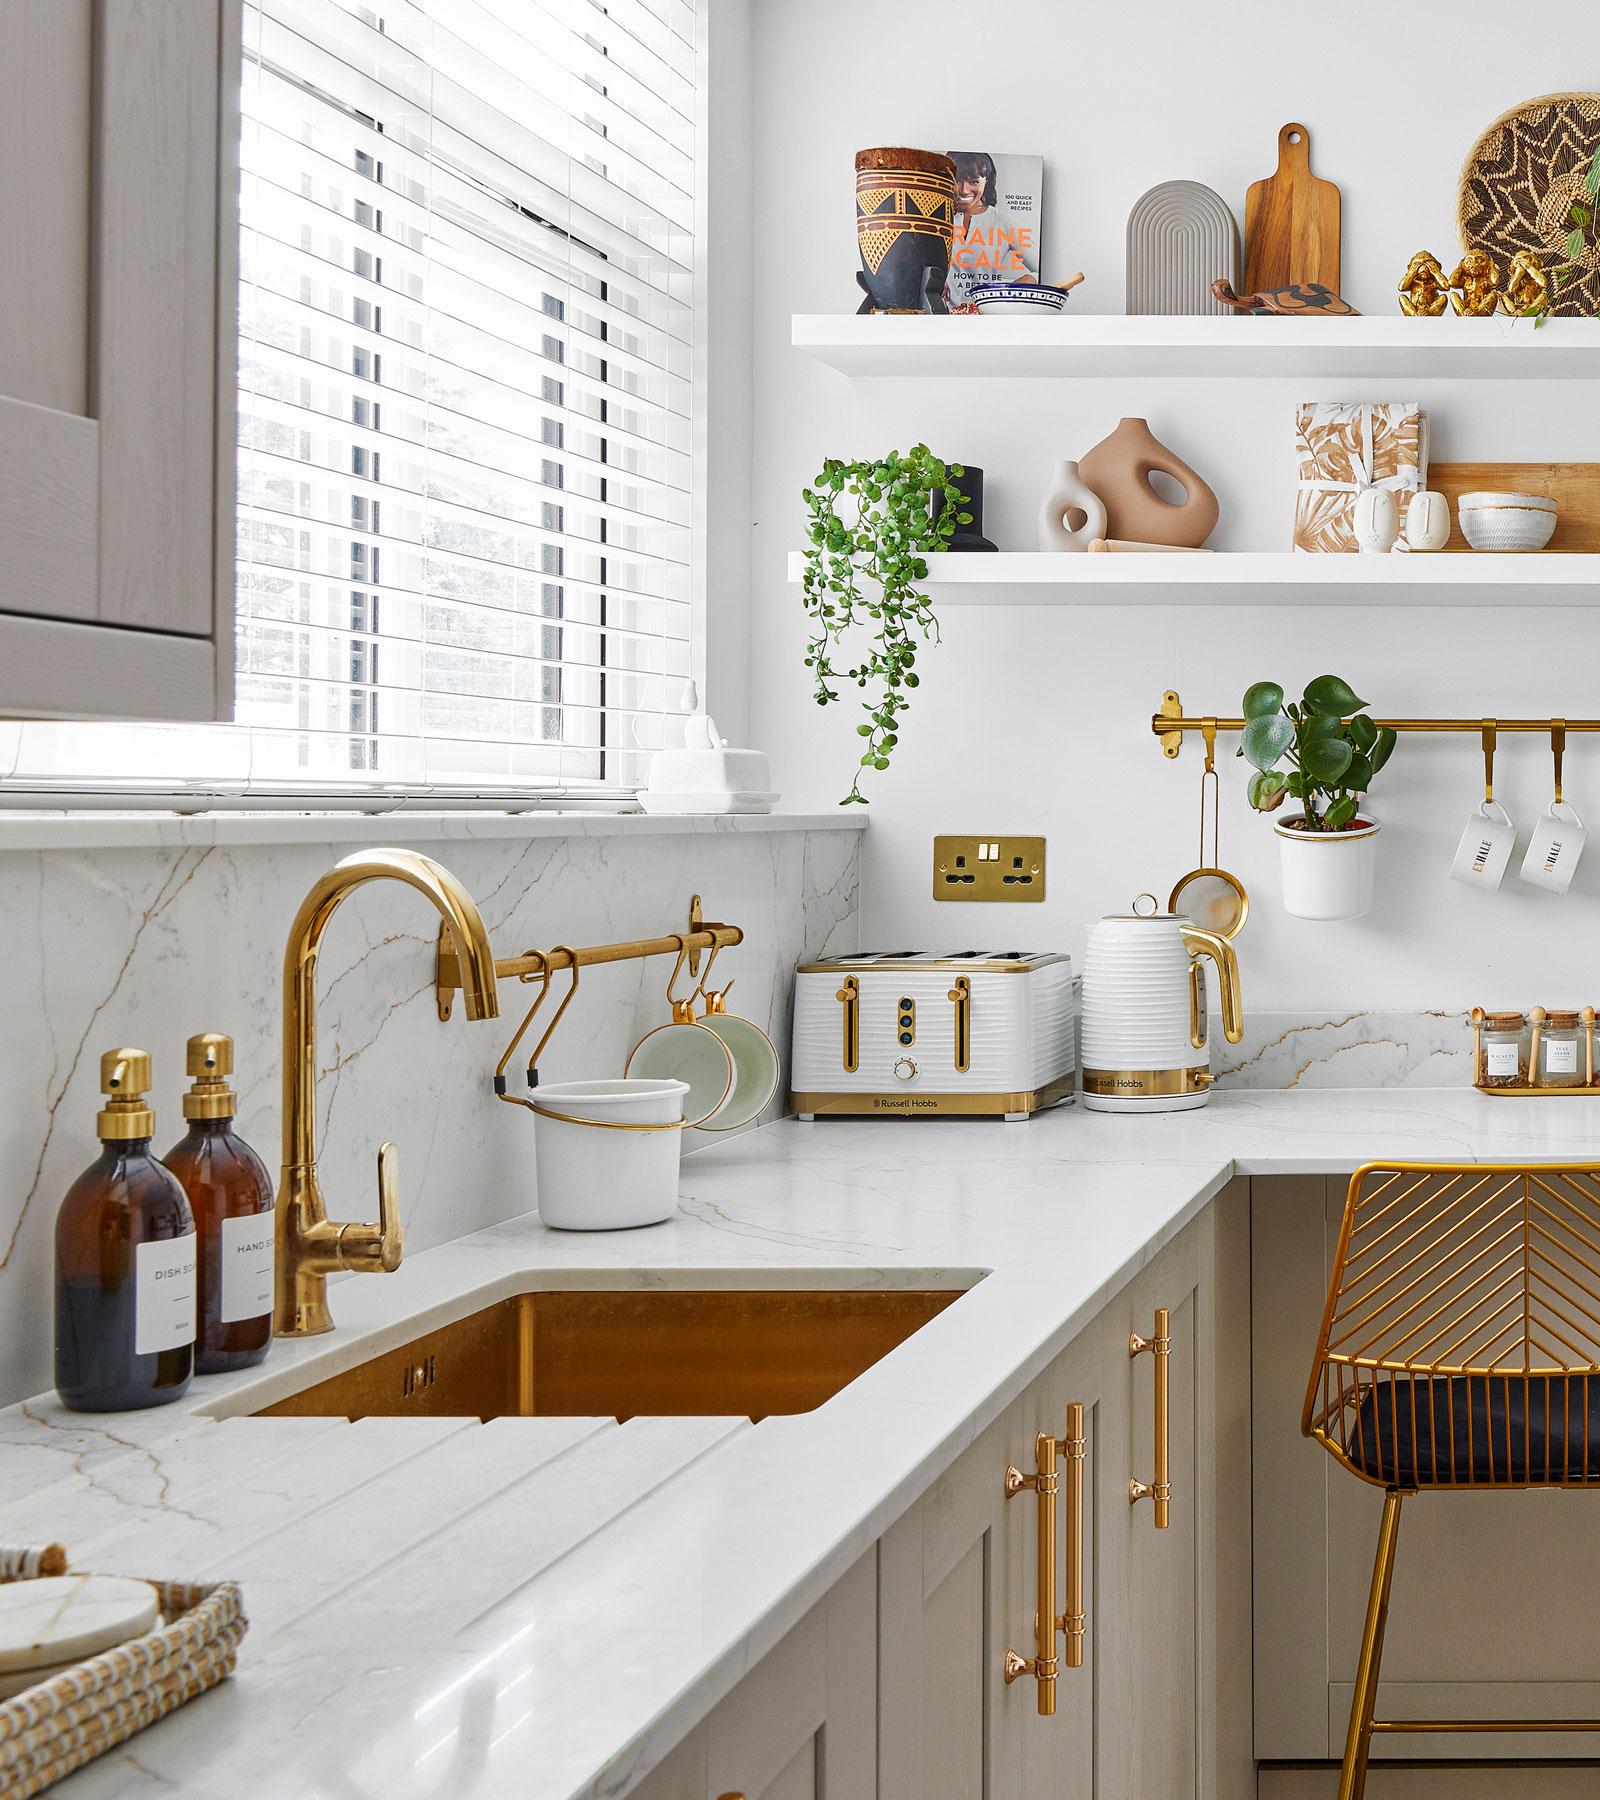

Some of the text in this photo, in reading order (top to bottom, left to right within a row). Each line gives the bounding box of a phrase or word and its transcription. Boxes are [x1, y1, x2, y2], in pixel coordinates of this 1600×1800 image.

[950, 247, 1025, 270] CALE
[953, 272, 975, 280] HOW
[977, 273, 990, 281] TO
[1472, 840, 1492, 873] EXHALE
[1543, 841, 1562, 873] INHALE
[1117, 1080, 1144, 1088] Hobbs
[881, 1099, 910, 1107] Russell
[237, 1241, 264, 1254] HAND
[155, 1268, 181, 1280] DISH
